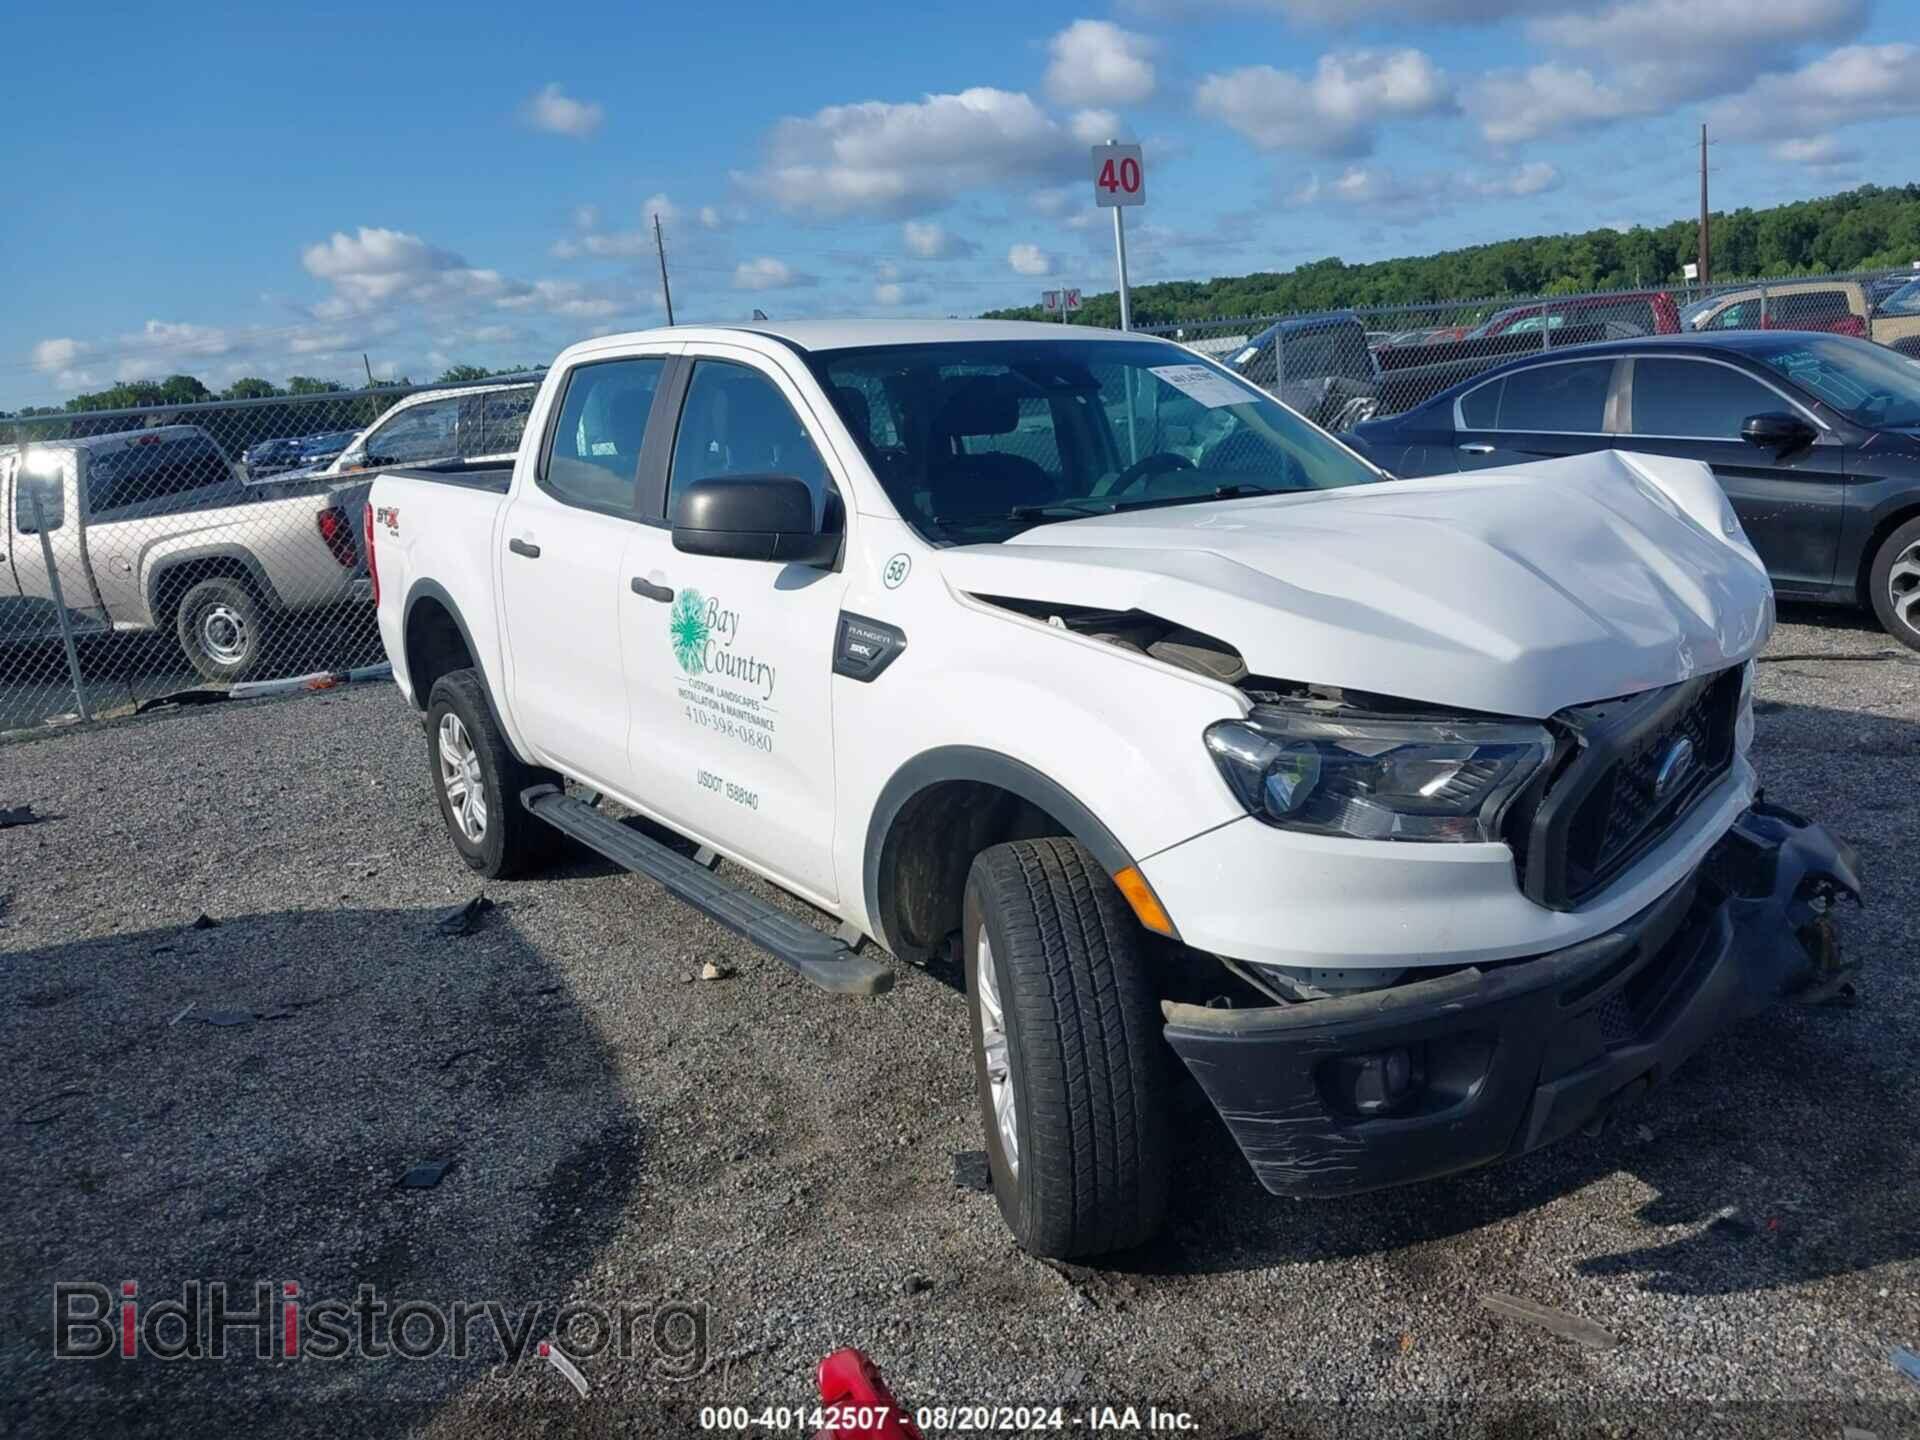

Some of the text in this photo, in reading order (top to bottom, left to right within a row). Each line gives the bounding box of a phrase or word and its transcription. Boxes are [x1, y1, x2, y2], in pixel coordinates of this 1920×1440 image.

[1098, 158, 1140, 193] 40
[1047, 293, 1056, 308] J
[1067, 292, 1078, 306] K
[887, 560, 906, 582] 58
[705, 596, 740, 647] Bay
[848, 626, 891, 645] RANGER
[703, 639, 776, 701] Country
[678, 687, 720, 710] INSTALLATION
[726, 705, 775, 732] MAINTENANCE
[688, 677, 760, 712] CUSTOM LANDSCAPES
[697, 768, 723, 793] USDOT
